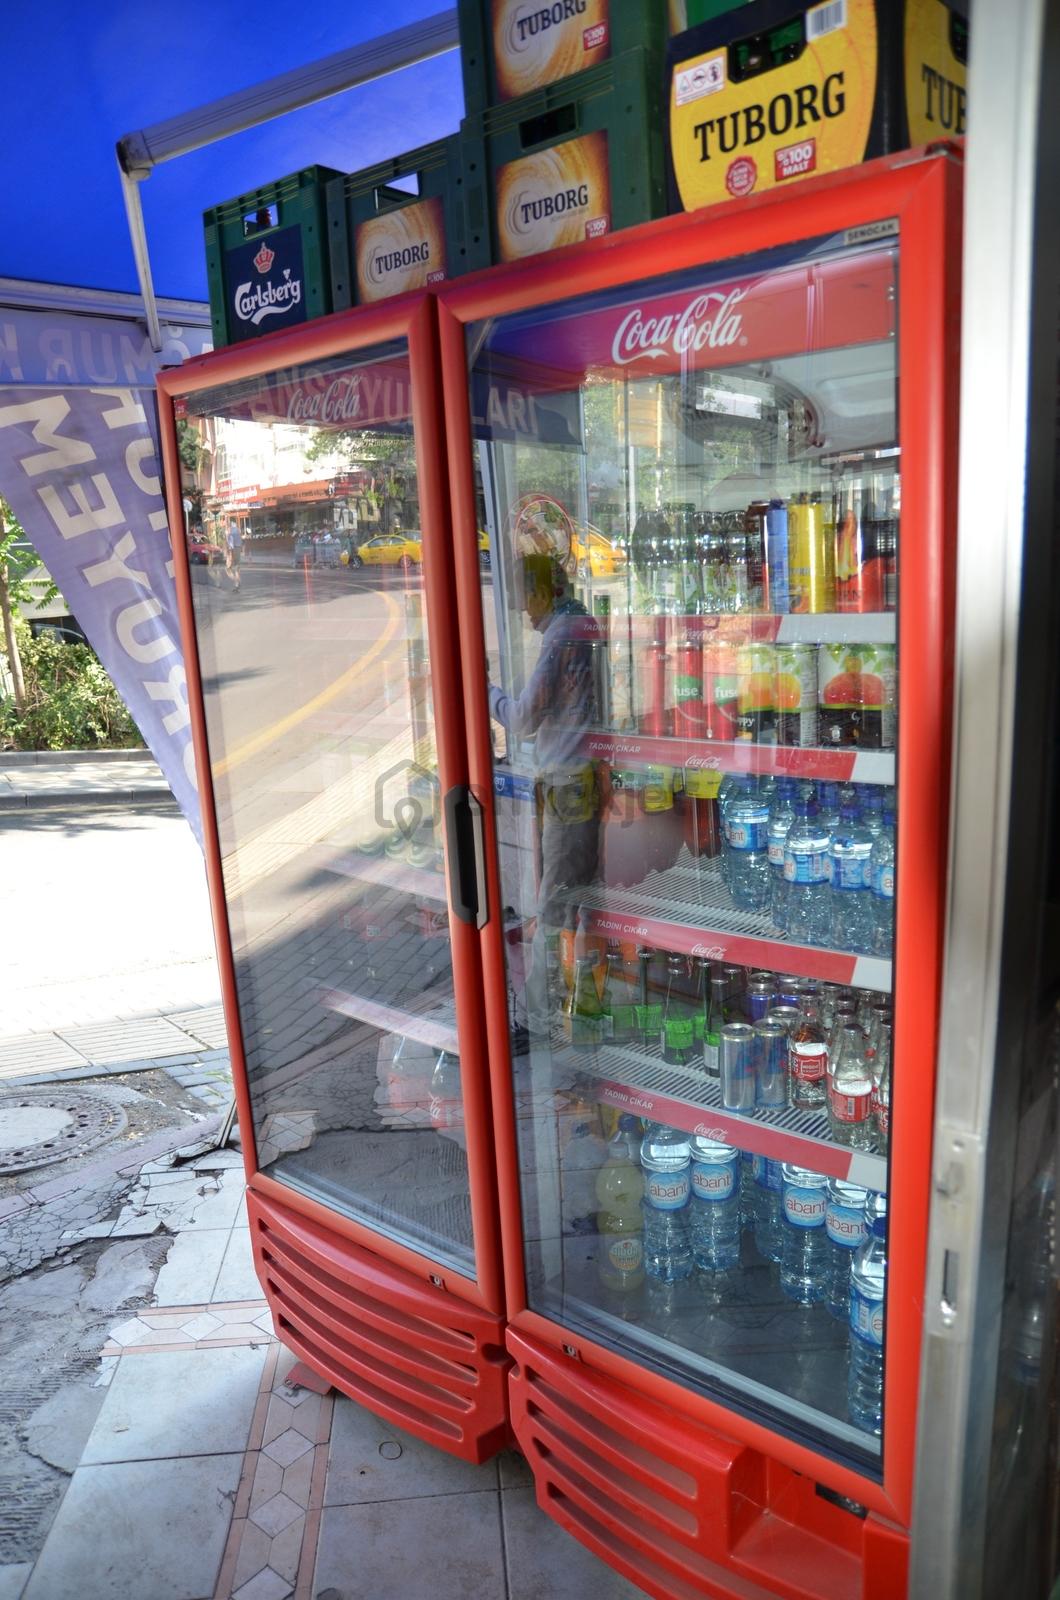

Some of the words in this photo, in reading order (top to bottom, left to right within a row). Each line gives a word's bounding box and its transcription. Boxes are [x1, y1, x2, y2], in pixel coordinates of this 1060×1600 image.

[516, 0, 587, 42] TUBORG
[693, 71, 846, 163] TUBORG
[782, 161, 808, 177] MALT
[521, 184, 589, 225] TUBORG
[375, 241, 430, 275] TUBORG
[234, 268, 301, 326] Carlsberg
[611, 287, 745, 366] Coca-Cola
[589, 742, 615, 752] TADINI
[596, 919, 622, 931] TADINI
[604, 1088, 628, 1103] TADINI
[650, 1183, 687, 1198] abant
[692, 1174, 731, 1190] abant
[786, 1199, 826, 1215] abant
[826, 1213, 865, 1234] abant
